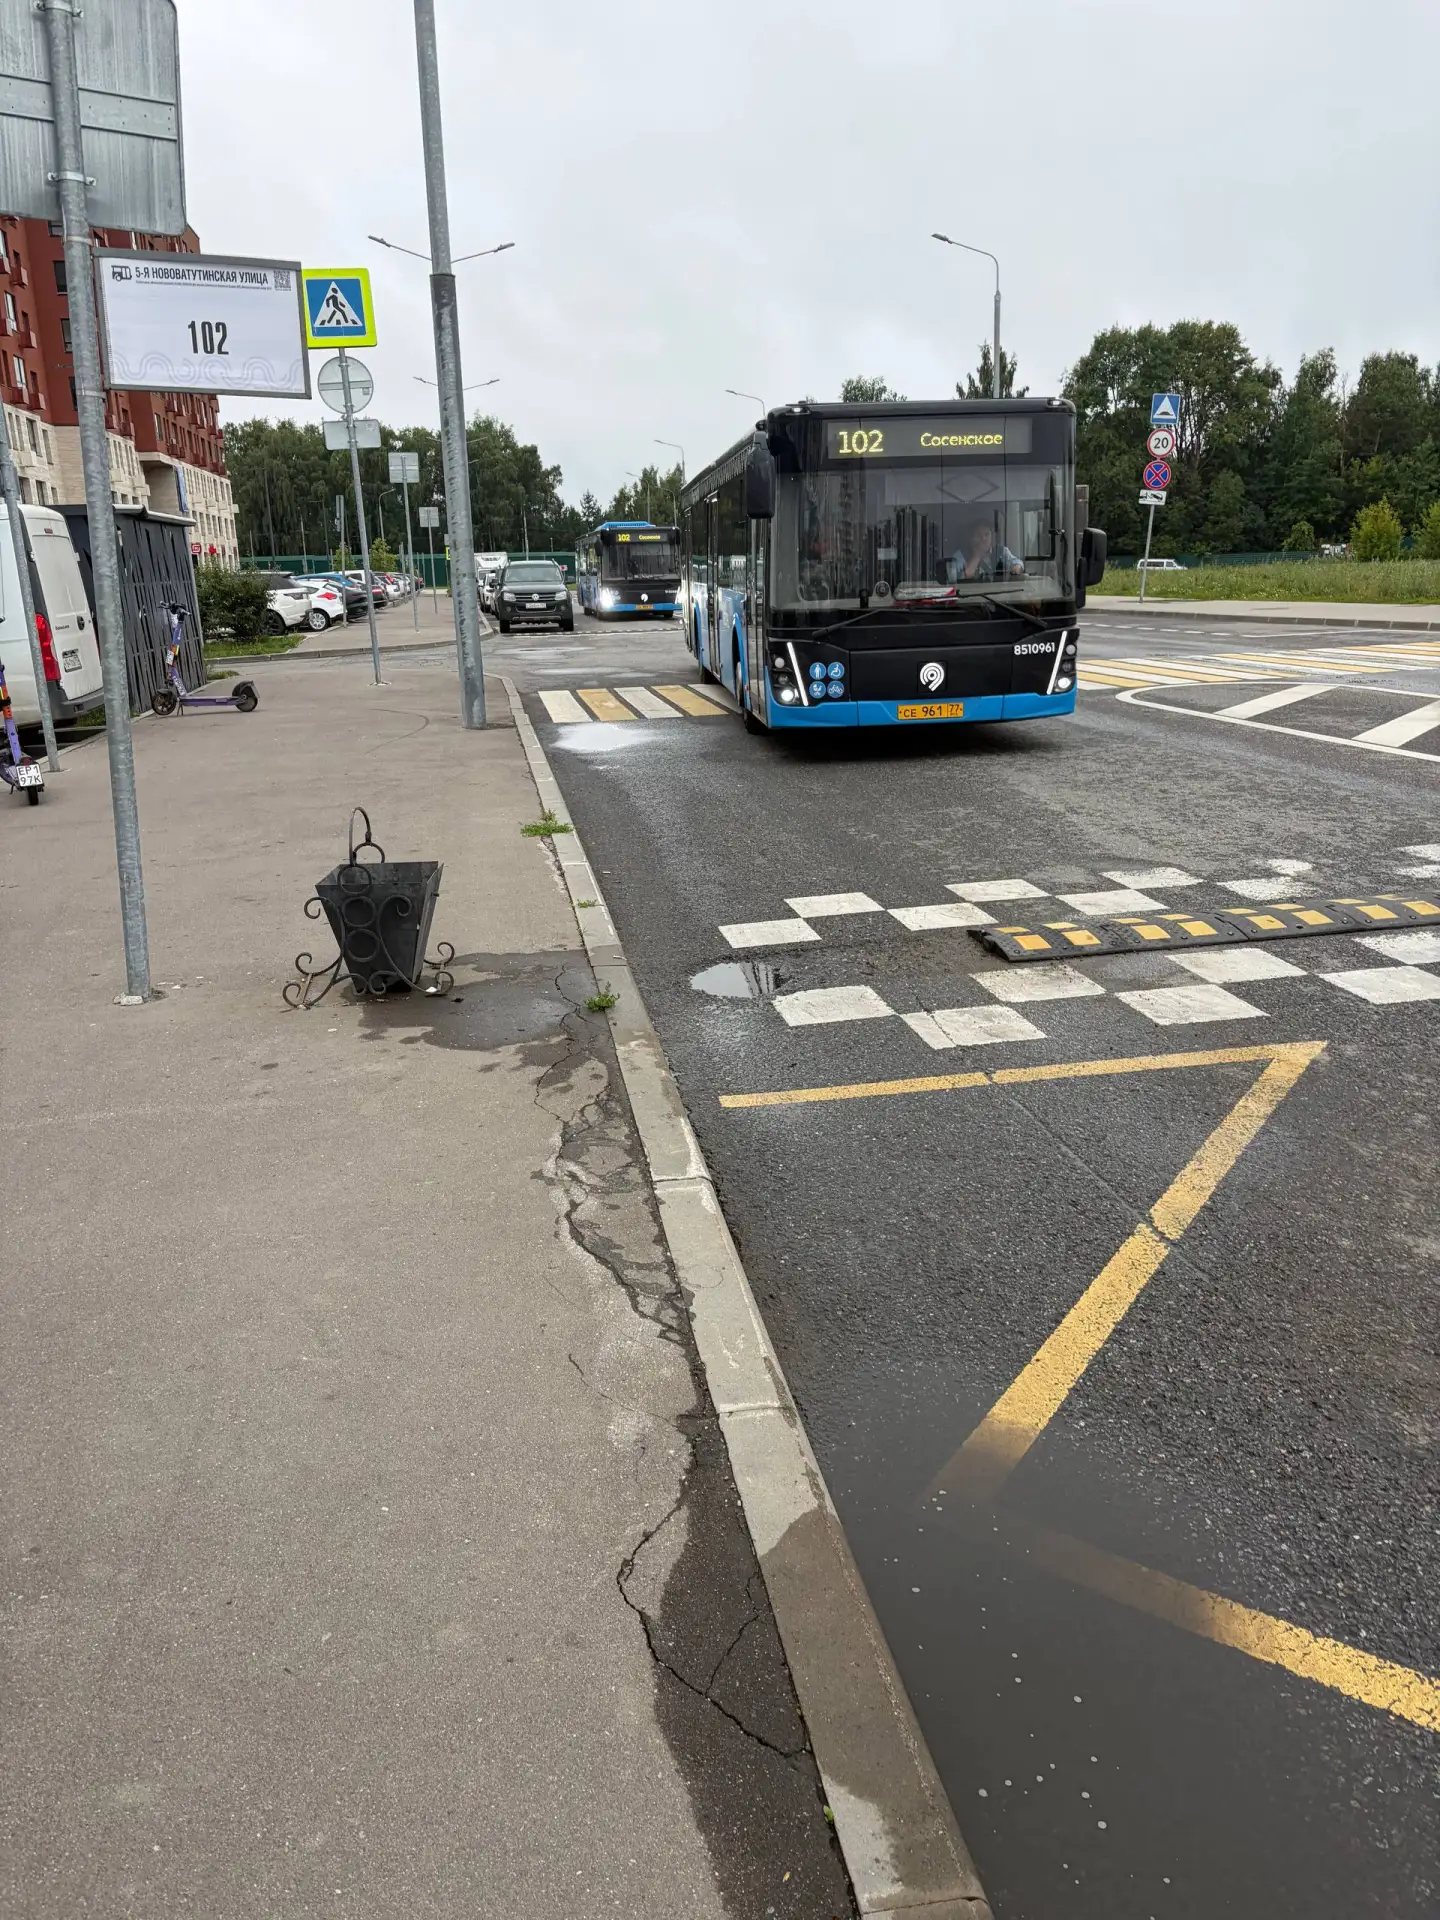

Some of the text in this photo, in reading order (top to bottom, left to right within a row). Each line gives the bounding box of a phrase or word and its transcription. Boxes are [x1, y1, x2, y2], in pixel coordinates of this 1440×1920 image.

[135, 266, 150, 279] 5-Я
[151, 267, 237, 283] НОВОВАТУТИНСКАЯ
[238, 271, 269, 286] УЛИЦА
[187, 320, 229, 355] 102
[838, 429, 884, 454] 102
[920, 432, 1003, 447] Сосенское
[1153, 437, 1169, 449] 20
[617, 533, 631, 542] 102
[1013, 641, 1056, 656] 8510961
[921, 704, 943, 717] 961
[949, 703, 960, 713] 77
